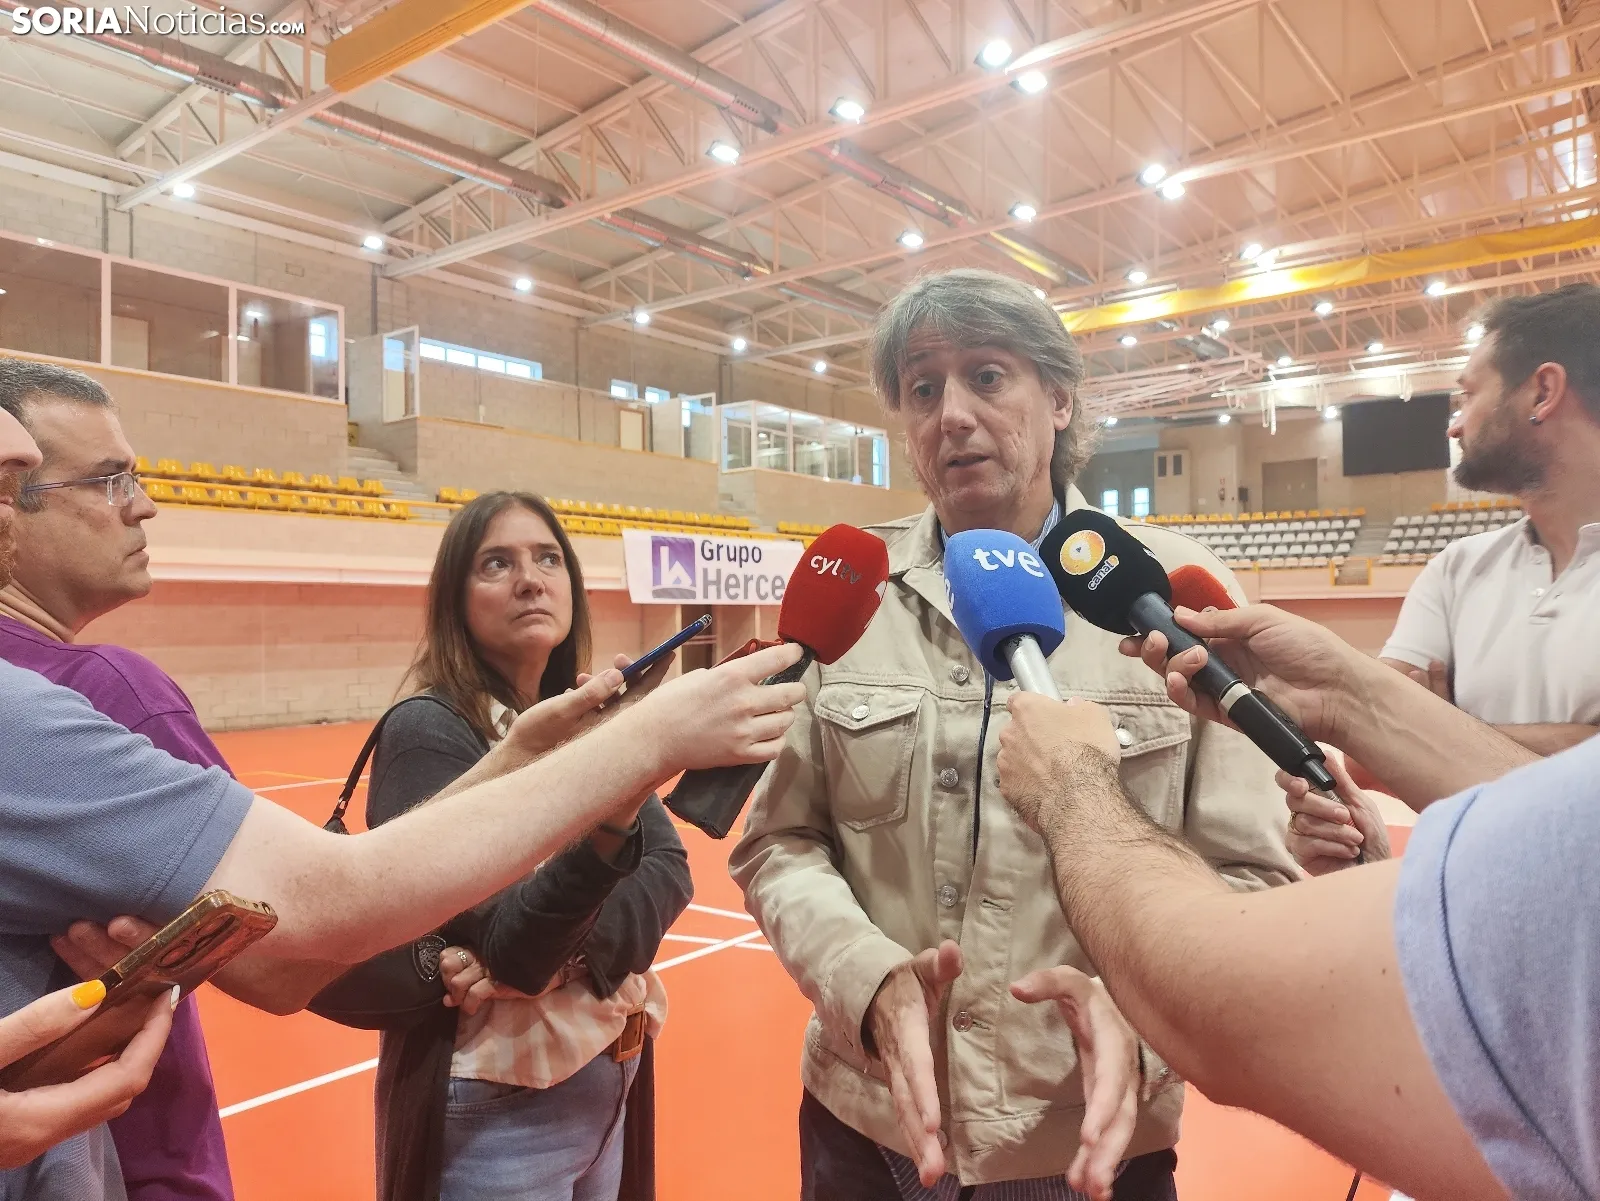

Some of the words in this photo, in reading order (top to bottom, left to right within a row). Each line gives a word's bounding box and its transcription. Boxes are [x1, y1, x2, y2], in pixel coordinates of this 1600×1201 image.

[700, 539, 762, 568] Grupo
[972, 548, 1045, 578] tve
[702, 567, 786, 601] Herce
[1088, 560, 1115, 590] canal
